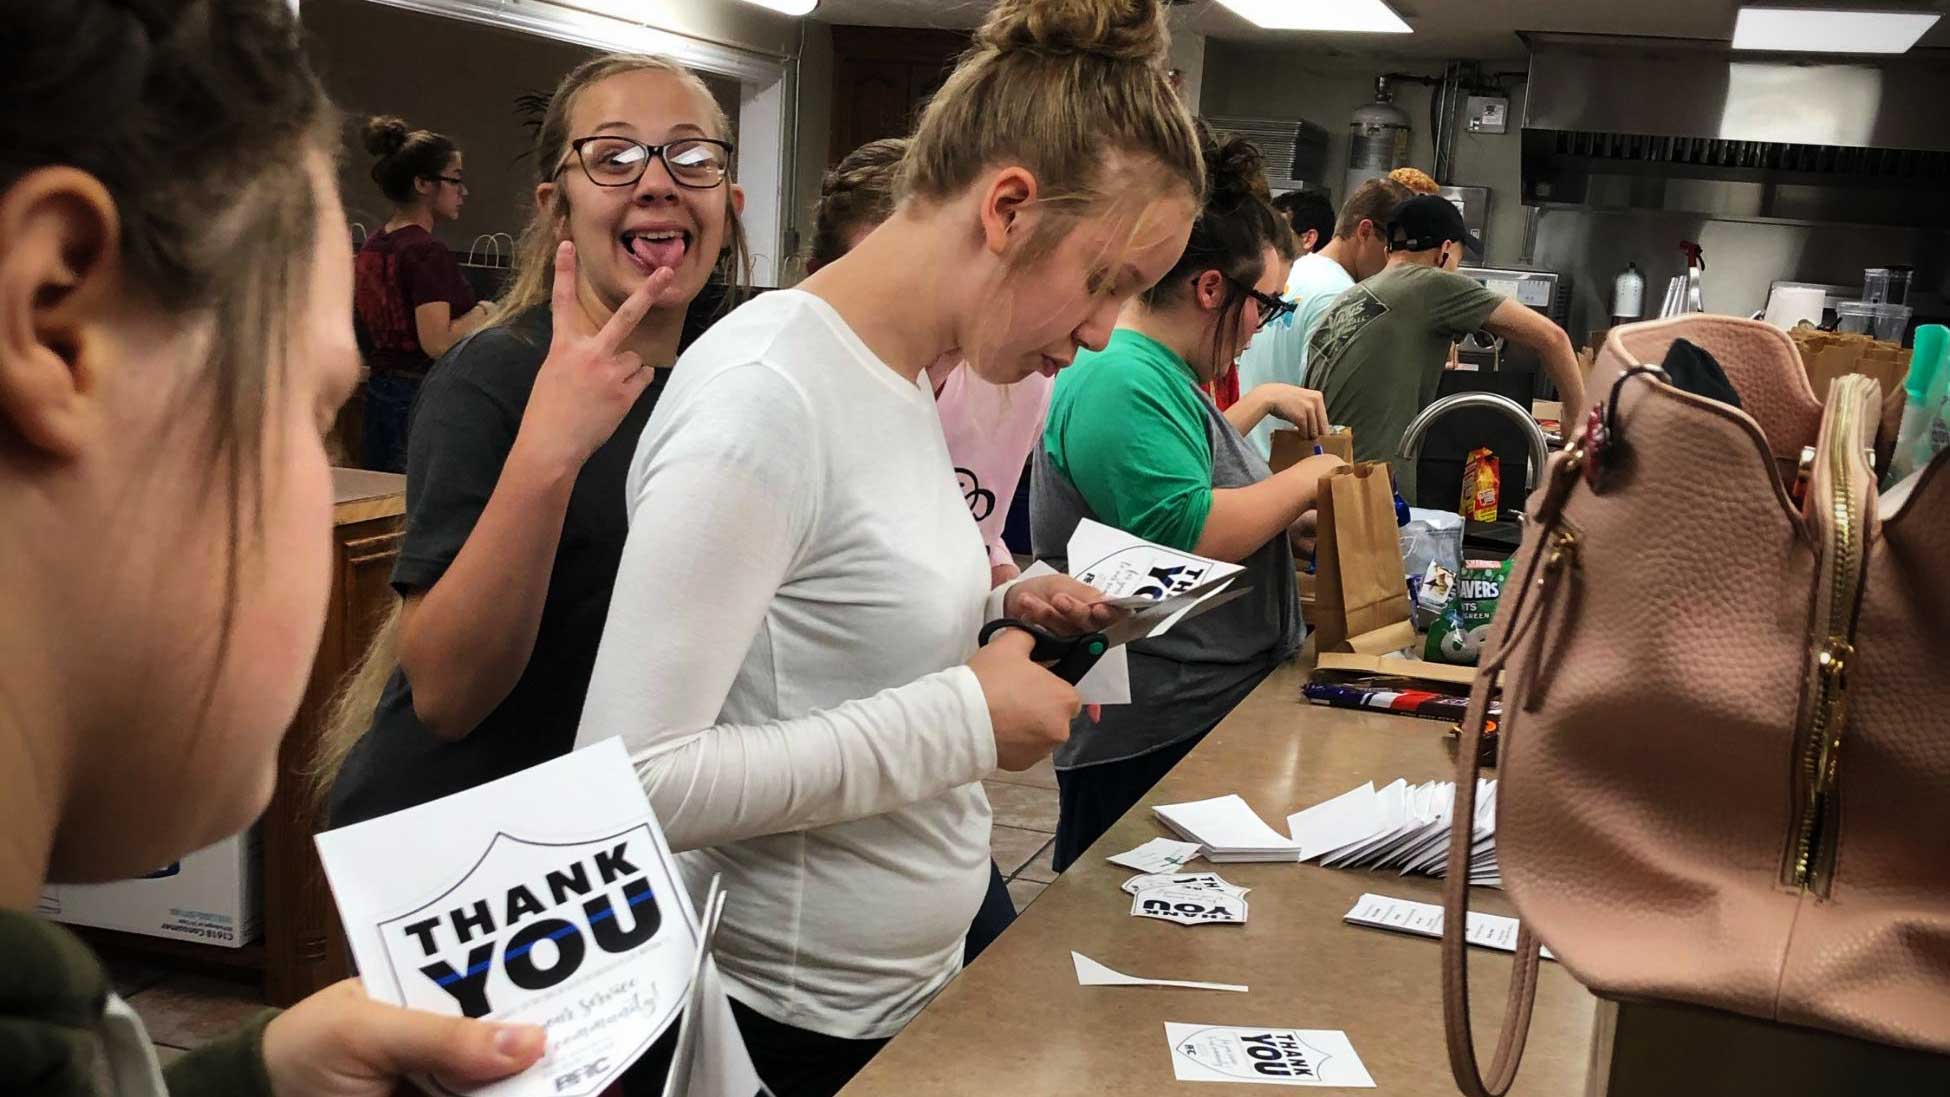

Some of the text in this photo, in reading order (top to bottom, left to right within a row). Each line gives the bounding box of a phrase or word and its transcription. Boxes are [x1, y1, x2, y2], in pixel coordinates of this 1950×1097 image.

[1131, 565, 1186, 600] YO
[1460, 580, 1499, 599] AVERS
[404, 842, 640, 956] THANK
[1143, 900, 1233, 916] YOU
[418, 876, 663, 1019] YOU
[1241, 1034, 1292, 1076] YOU
[1276, 1034, 1313, 1076] THANK
